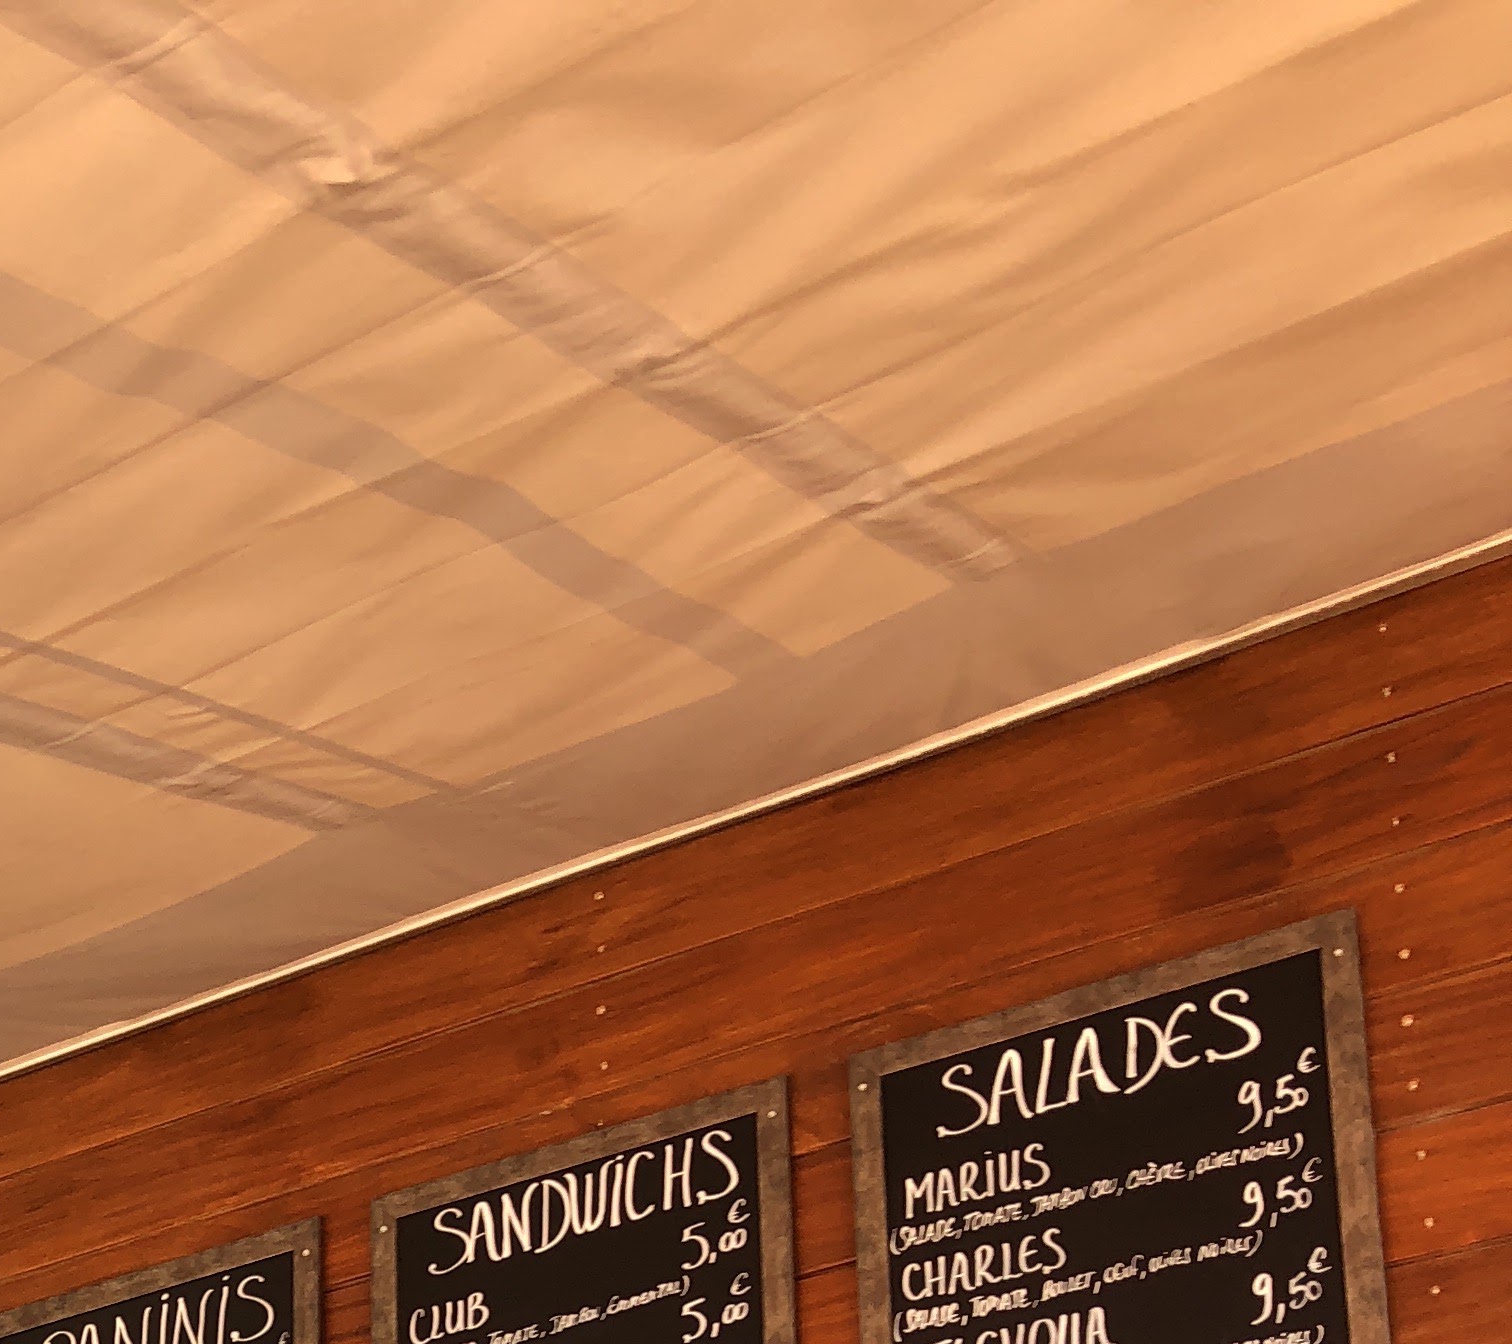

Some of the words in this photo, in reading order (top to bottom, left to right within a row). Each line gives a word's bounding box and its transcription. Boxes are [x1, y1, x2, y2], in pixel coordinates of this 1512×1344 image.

[936, 988, 1263, 1138] SALADES
[428, 1129, 740, 1275] SANDWICHS
[904, 1142, 1052, 1219] MARIUS
[901, 1227, 1068, 1302] CHARLES
